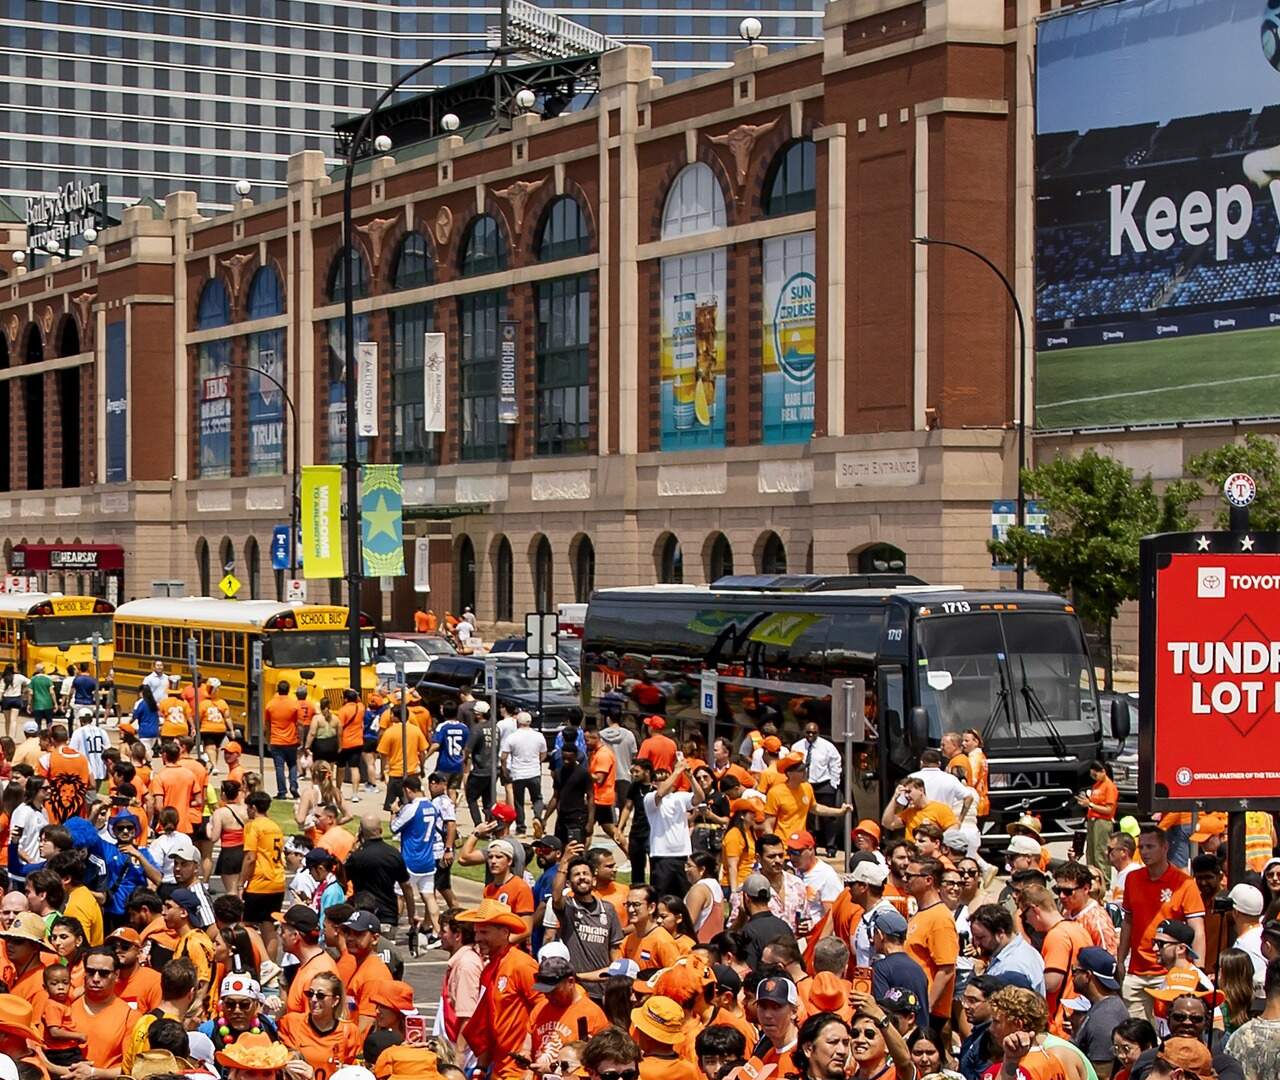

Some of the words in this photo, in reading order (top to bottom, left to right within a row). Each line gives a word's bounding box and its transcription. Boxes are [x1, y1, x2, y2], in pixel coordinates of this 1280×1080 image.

[1110, 179, 1253, 261] Keep
[790, 285, 813, 301] SUN
[363, 359, 373, 417] ARLINGTON
[253, 423, 283, 446] TRULY
[841, 463, 871, 476] SOUTH
[872, 460, 917, 475] ENTRANCE
[319, 484, 331, 560] WELCOME
[61, 551, 98, 564] HEARSAY
[56, 602, 79, 613] SCHOOL
[79, 601, 93, 612] BUS
[941, 601, 971, 615] 1713
[300, 612, 327, 626] SCHOOL
[329, 611, 344, 625] BUS
[887, 628, 903, 641] 1713
[1190, 681, 1263, 715] LOT
[86, 736, 104, 754] 10
[447, 736, 463, 757] 15
[1194, 772, 1218, 780] OFFICIAL
[1219, 772, 1245, 780] PARTNER
[423, 815, 436, 842] 7
